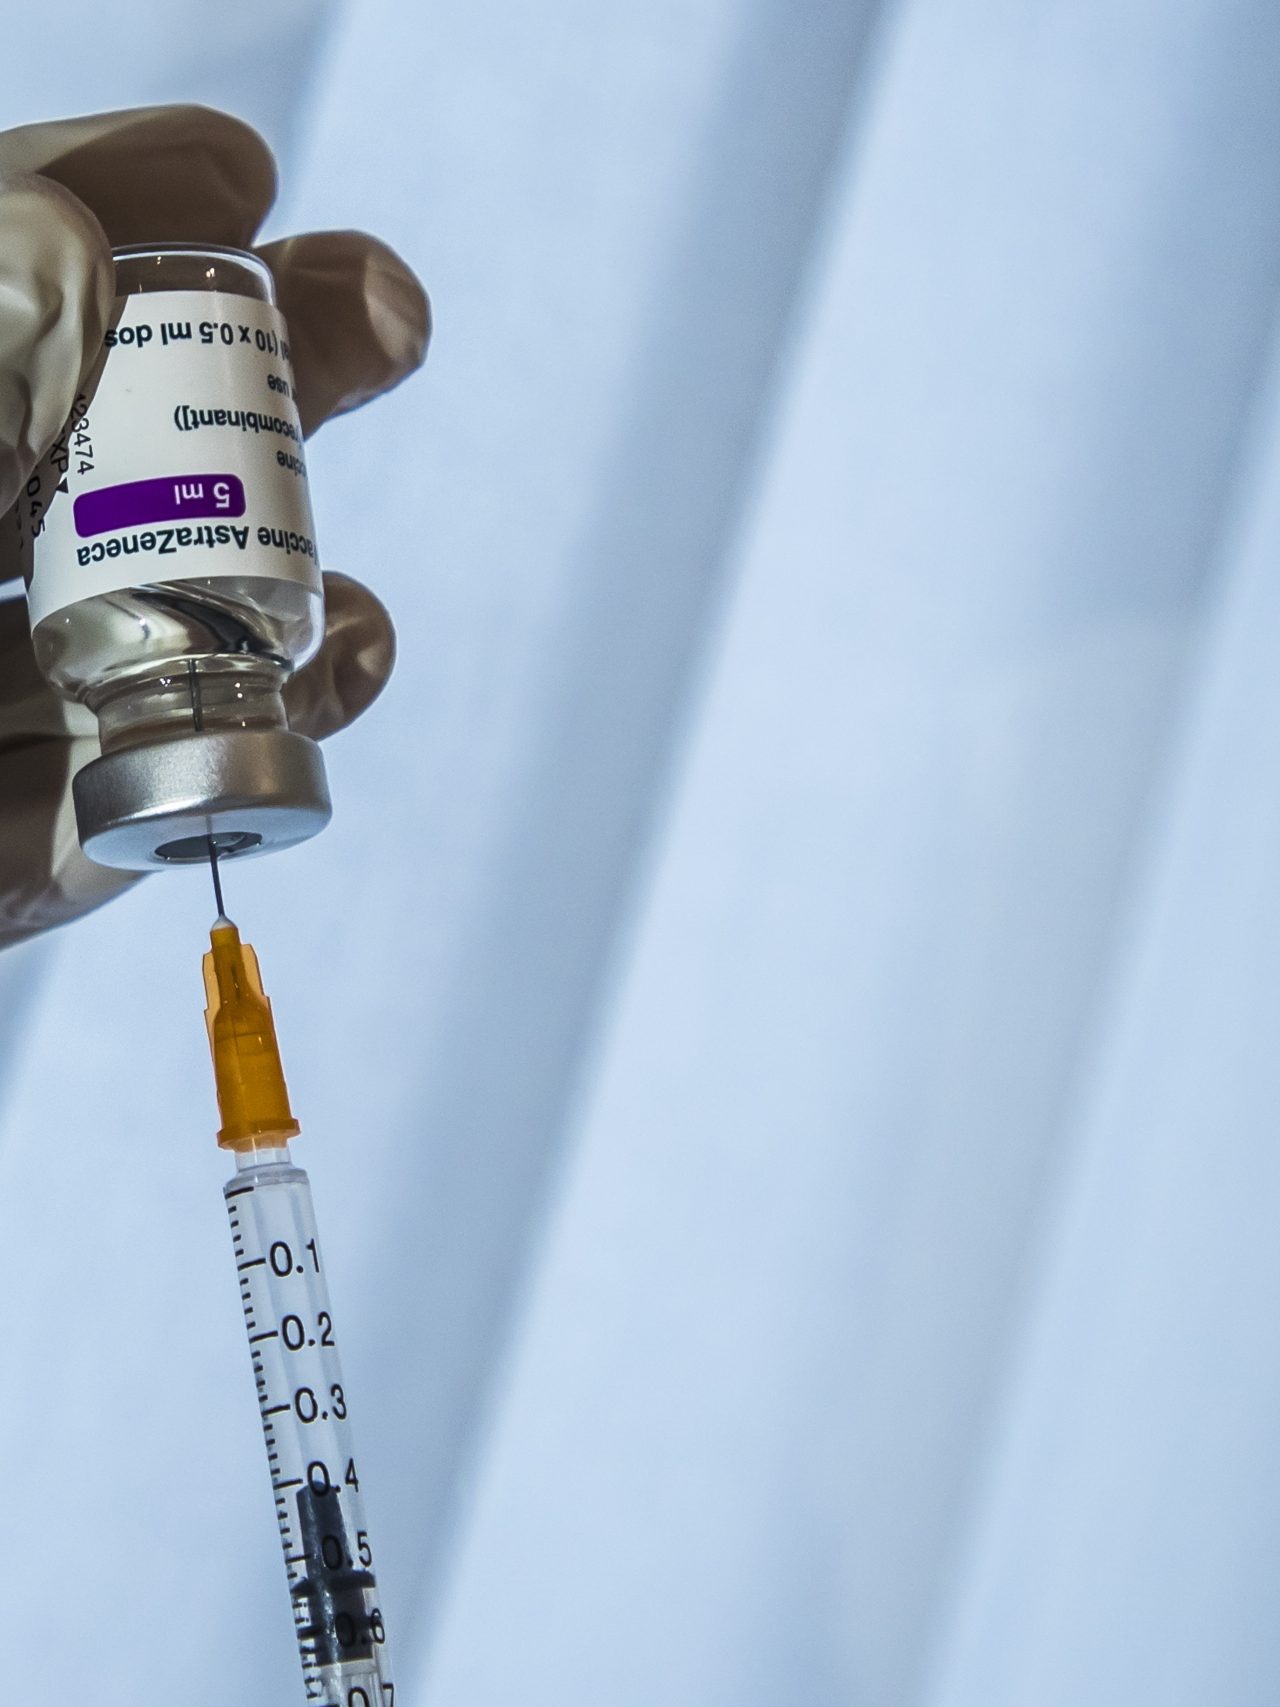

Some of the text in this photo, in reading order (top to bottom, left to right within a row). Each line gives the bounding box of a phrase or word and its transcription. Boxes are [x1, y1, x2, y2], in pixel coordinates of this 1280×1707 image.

[104, 323, 152, 348] dos
[161, 322, 192, 346] ml
[199, 322, 233, 345] 0.5
[238, 325, 251, 344] x
[255, 329, 278, 356] (10
[174, 405, 302, 443] recombinant])
[50, 427, 69, 474] XP
[174, 483, 230, 508] 5 ml
[76, 526, 250, 567] AstraZeneca
[270, 1238, 320, 1277] 0.1
[281, 1311, 335, 1351] 0.2
[294, 1383, 347, 1424] 0.3
[307, 1458, 359, 1497] 0.4
[322, 1531, 372, 1571] 0.5
